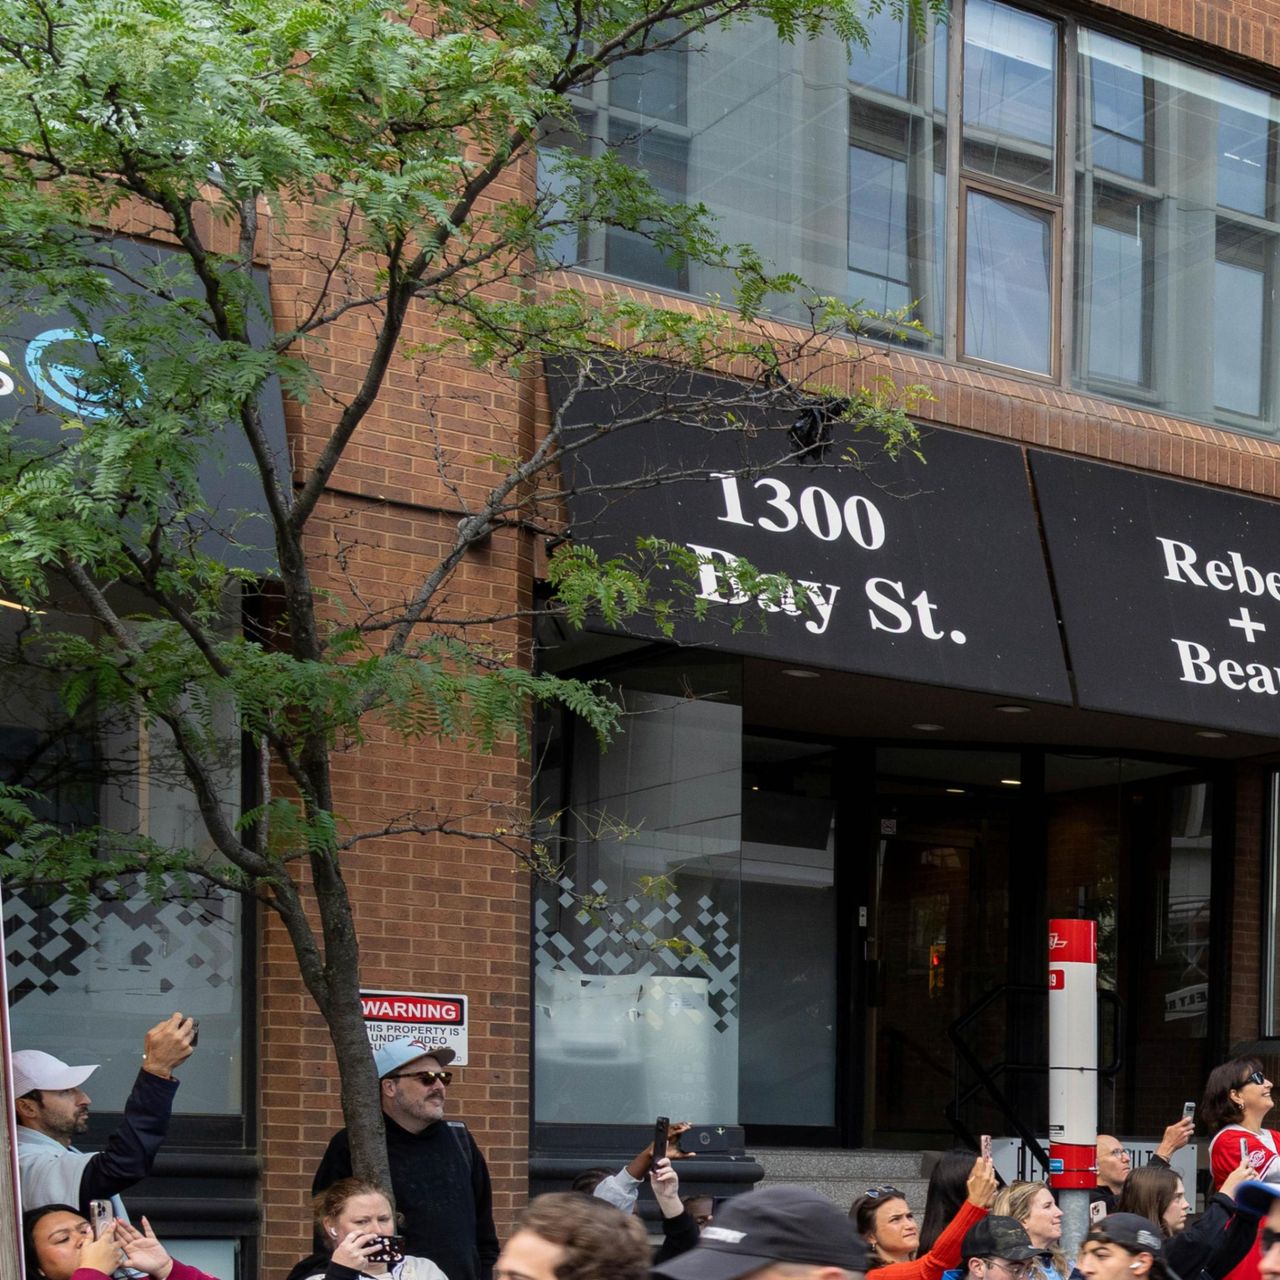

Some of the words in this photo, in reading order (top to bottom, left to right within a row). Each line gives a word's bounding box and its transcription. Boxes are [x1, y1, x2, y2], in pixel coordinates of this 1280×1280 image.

[710, 470, 886, 550] 1300
[865, 577, 967, 644] St.
[361, 1001, 456, 1019] WARNING
[365, 1024, 383, 1033] HIS
[387, 1025, 446, 1035] PROPERTY
[450, 1028, 460, 1036] IS
[371, 1034, 410, 1042] UNDE
